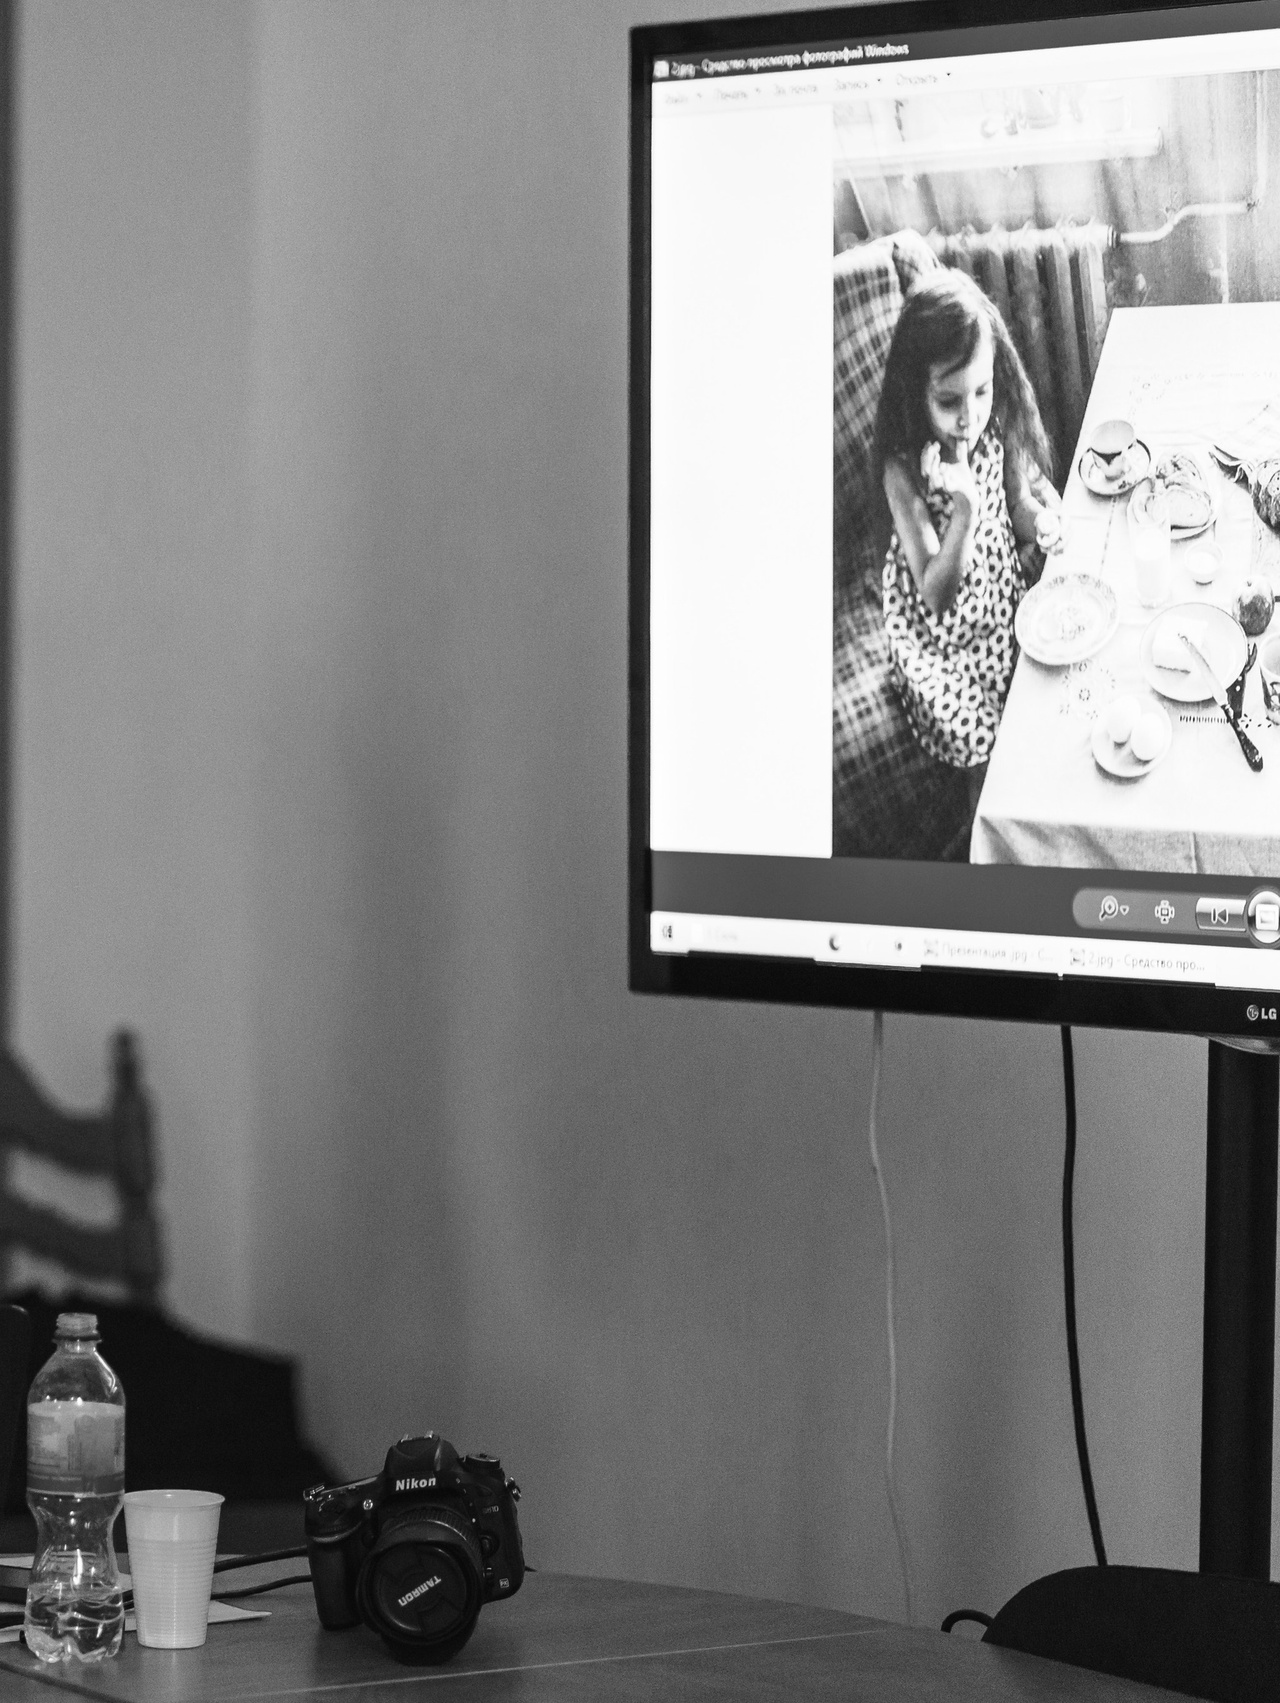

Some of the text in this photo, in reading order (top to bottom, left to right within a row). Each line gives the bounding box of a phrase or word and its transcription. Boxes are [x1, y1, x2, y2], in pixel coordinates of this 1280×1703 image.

[864, 43, 909, 58] Windows
[1124, 954, 1172, 970] Средство
[1261, 1006, 1277, 1021] LG
[395, 1477, 436, 1491] Nikon
[398, 1575, 441, 1606] TAMRON
